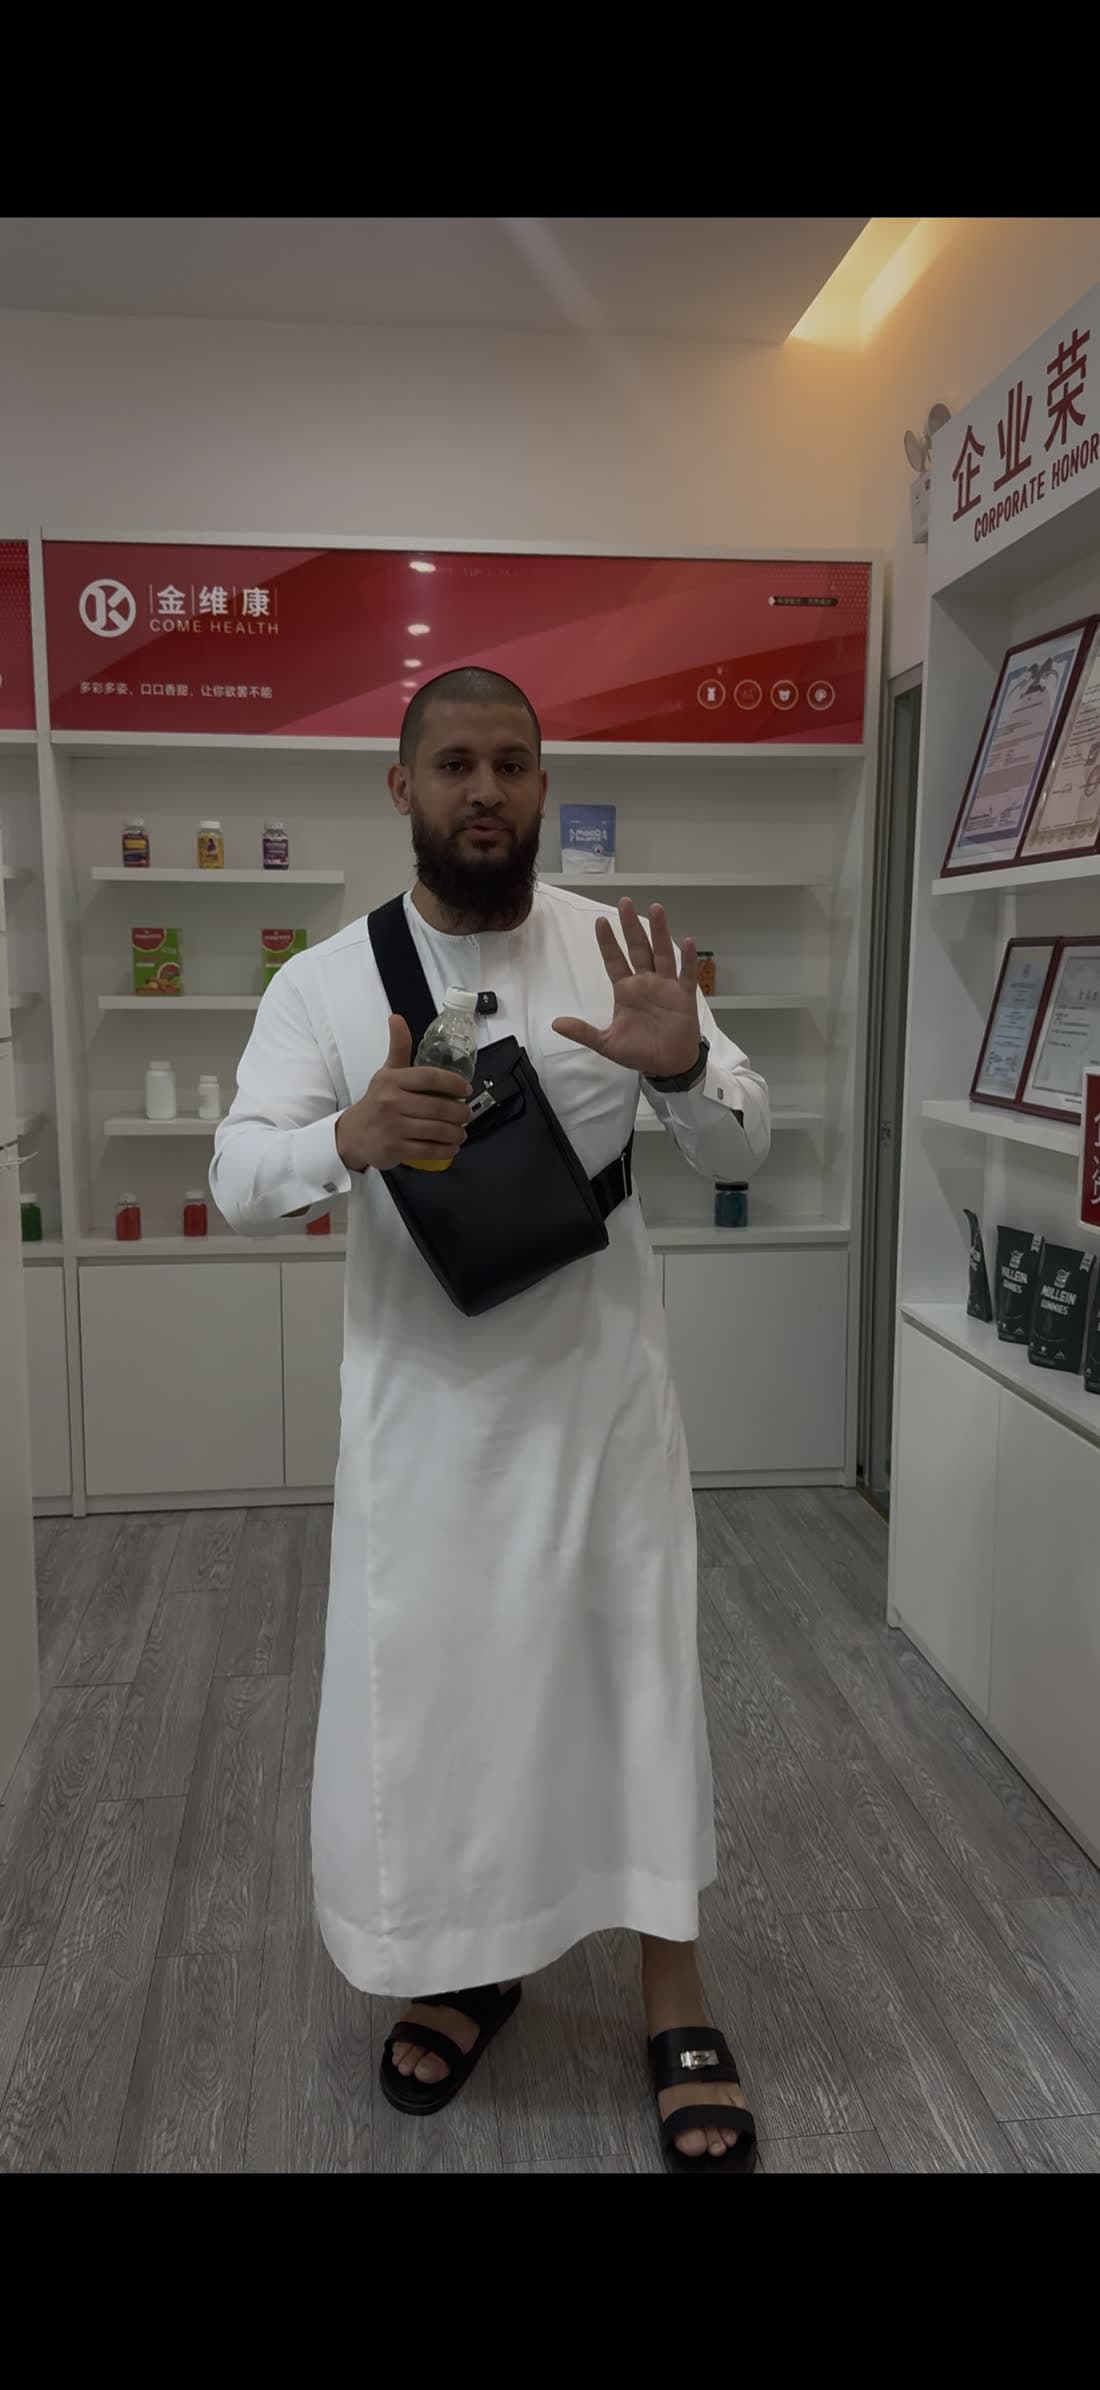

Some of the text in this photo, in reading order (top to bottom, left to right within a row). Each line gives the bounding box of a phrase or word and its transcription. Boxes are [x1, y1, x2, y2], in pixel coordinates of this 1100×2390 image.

[952, 329, 1090, 522] 企业荣
[974, 470, 1046, 542] CORPORATE
[150, 619, 279, 635] COME HEALTH
[157, 585, 270, 617] 金维康
